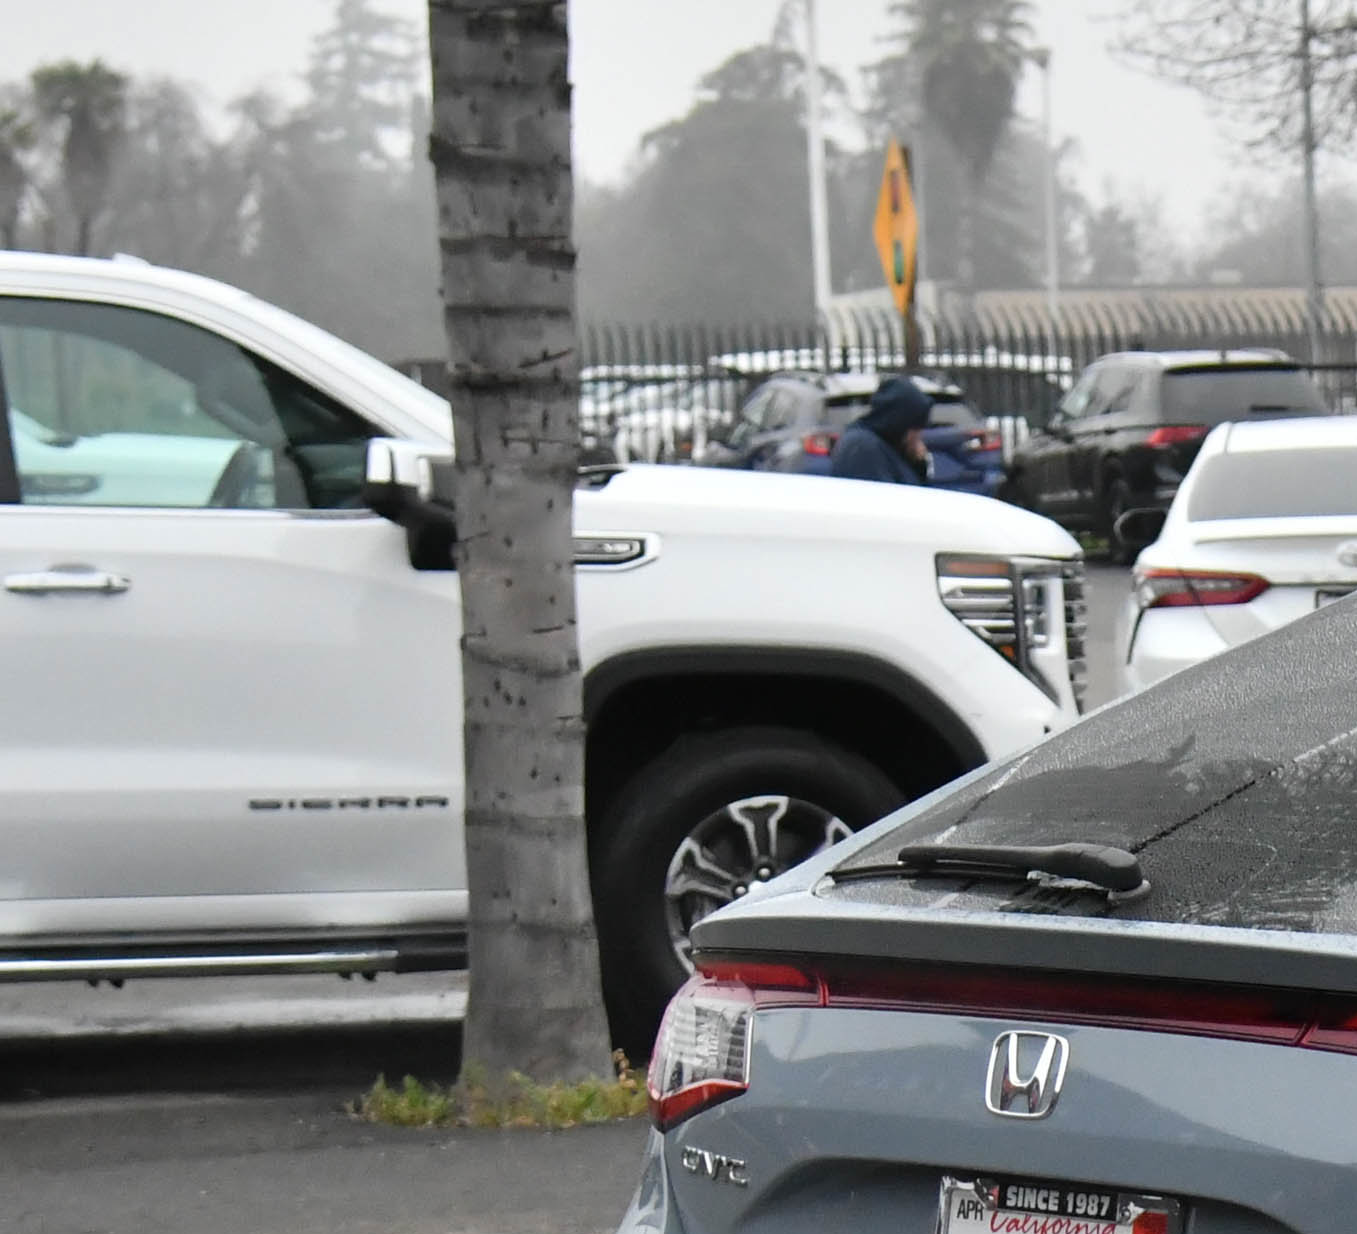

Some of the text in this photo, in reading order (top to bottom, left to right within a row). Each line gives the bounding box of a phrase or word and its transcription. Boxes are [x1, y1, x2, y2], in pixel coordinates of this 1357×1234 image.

[957, 1198, 983, 1221] APR
[1006, 1185, 1110, 1217] SINCE 1987
